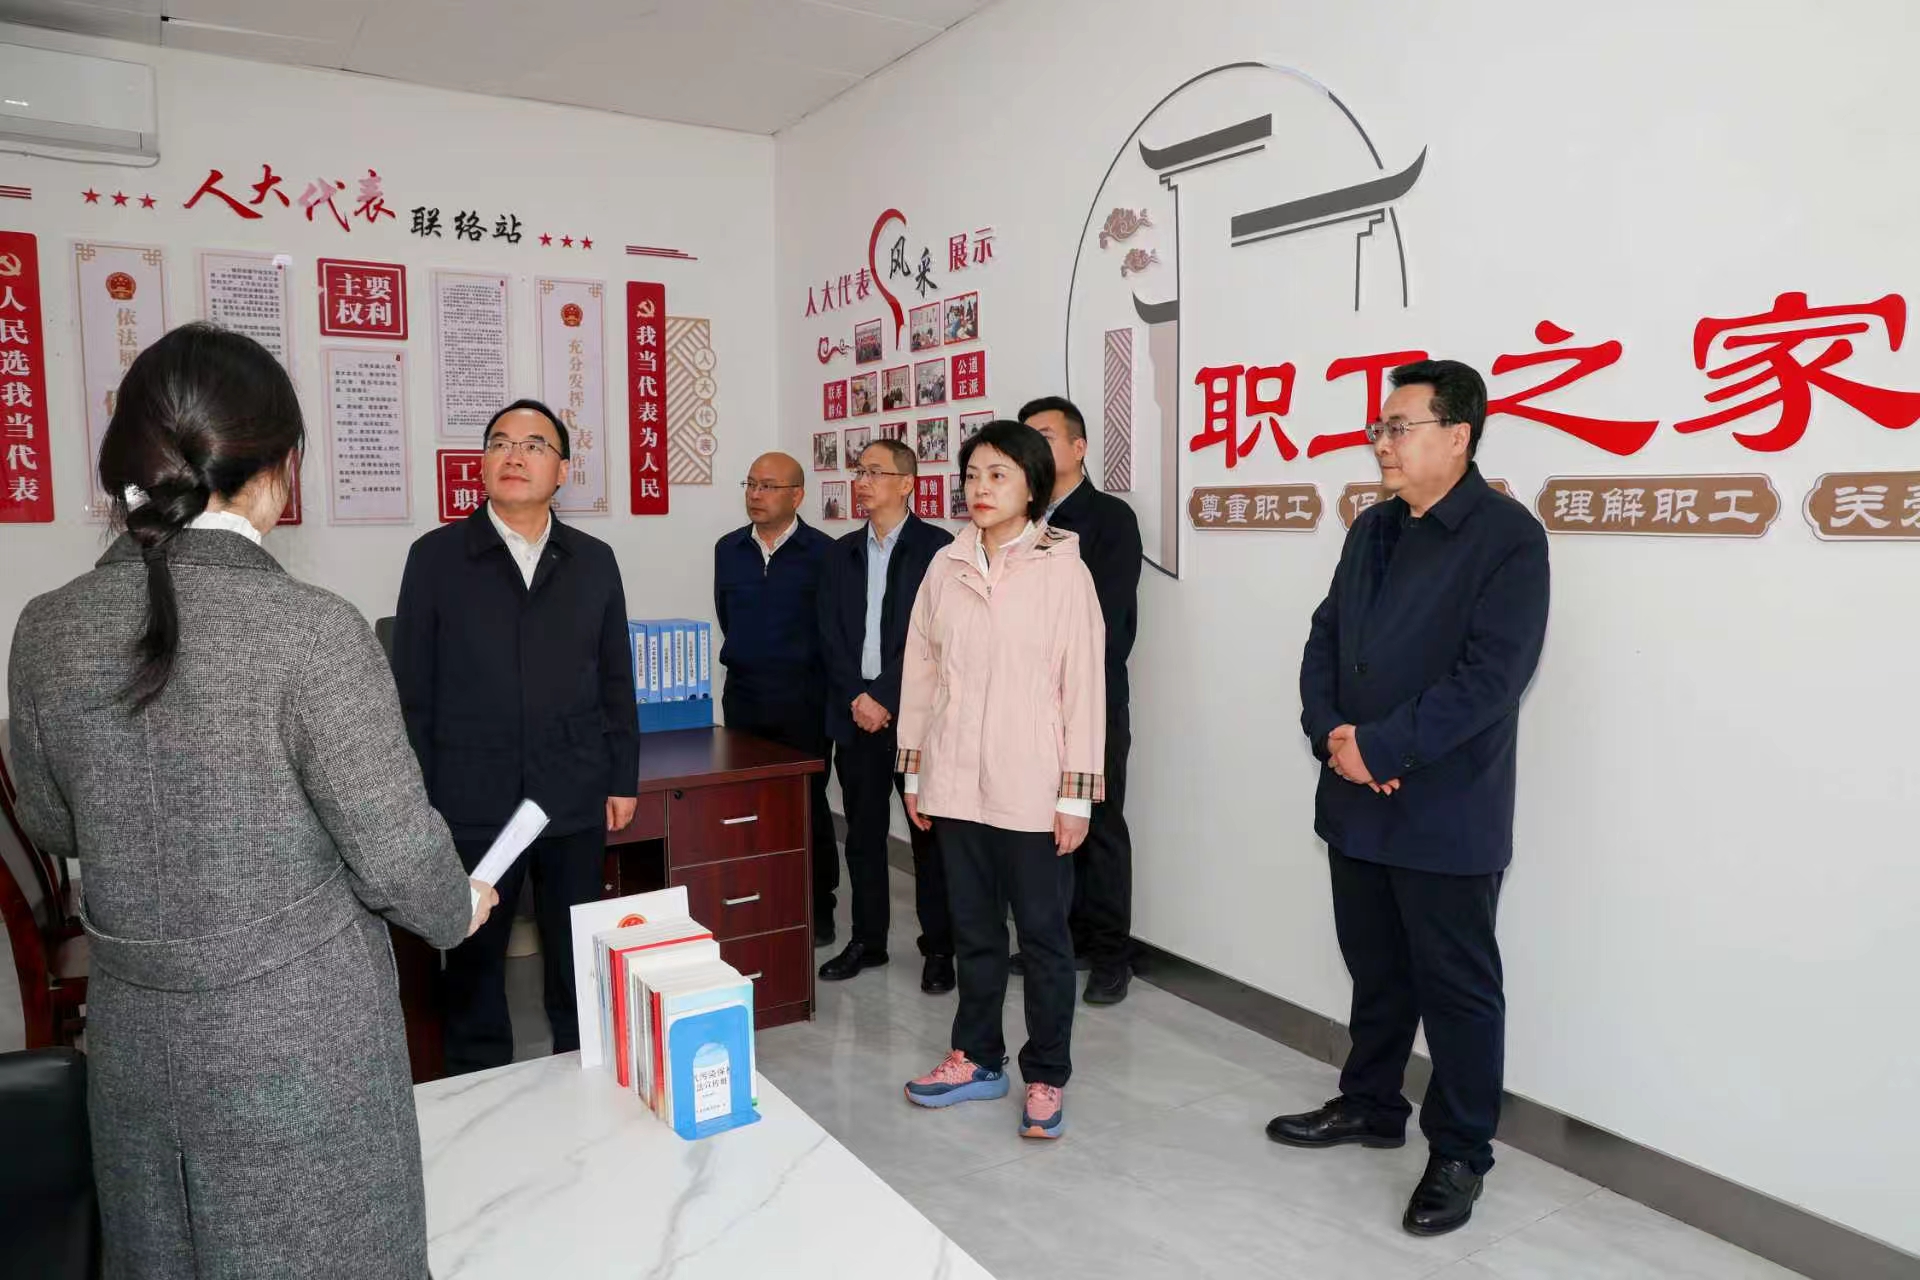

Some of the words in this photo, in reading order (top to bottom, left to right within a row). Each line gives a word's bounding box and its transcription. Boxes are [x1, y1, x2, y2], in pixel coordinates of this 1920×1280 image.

[805, 267, 870, 318] 人大代表
[889, 235, 937, 298] 风采
[949, 227, 993, 272] 展示
[335, 273, 391, 301] 主要
[335, 302, 392, 327] 权利
[957, 356, 978, 375] 公道
[0, 286, 39, 502] 人民选我当代表
[957, 379, 979, 396] 正派
[1190, 292, 1920, 468] 职工之家
[637, 325, 660, 499] 我当代表为人民
[699, 350, 712, 451] 人大代表
[451, 461, 482, 482] 工
[452, 488, 489, 511] 职
[1198, 495, 1317, 522] 尊重职工
[1554, 487, 1763, 525] 理解职工
